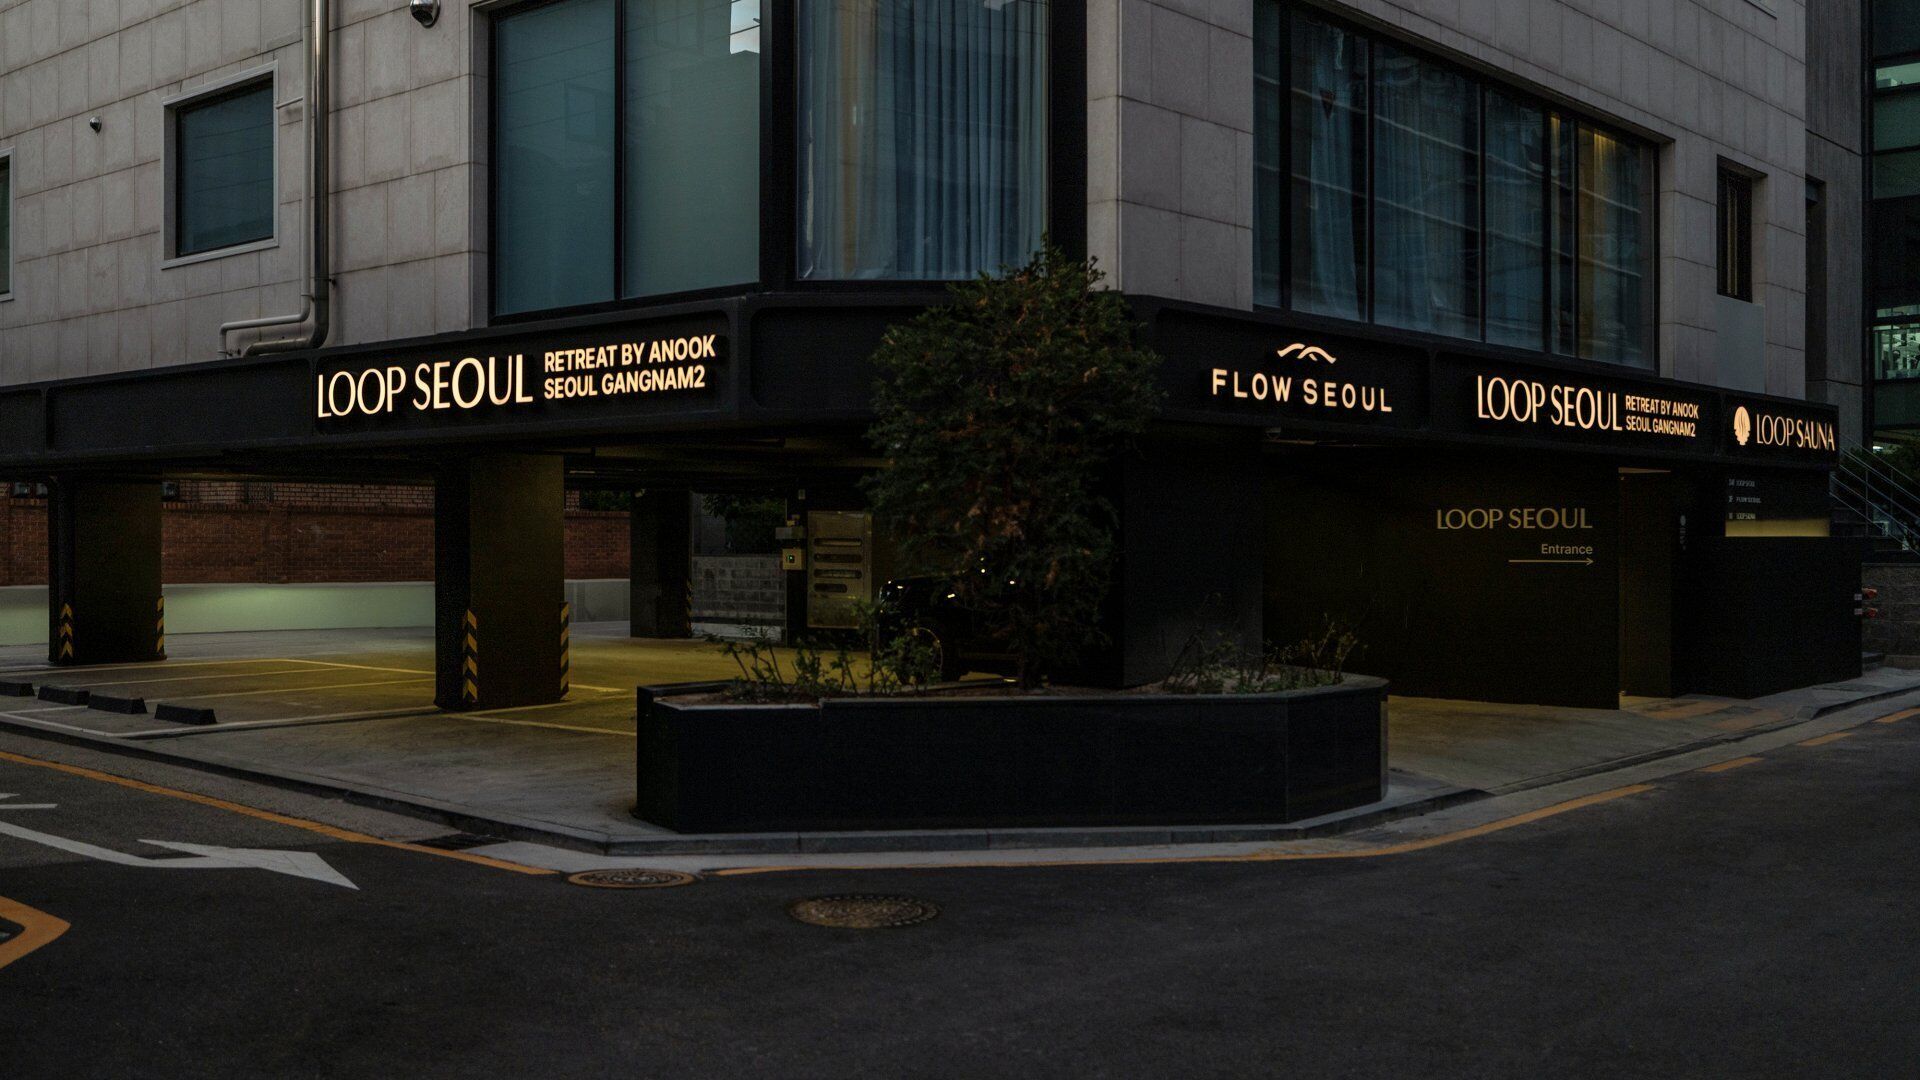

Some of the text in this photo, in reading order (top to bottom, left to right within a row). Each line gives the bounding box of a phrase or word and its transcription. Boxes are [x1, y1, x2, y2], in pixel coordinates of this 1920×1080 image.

[544, 334, 717, 373] RETREAT BY ANOOK
[317, 353, 534, 418] LOOP SEOUL
[543, 365, 706, 400] SEOUL GANGNAM2
[1211, 368, 1393, 413] FLOW SEOUL
[1477, 375, 1624, 431] LOOP SEOUL
[1625, 394, 1699, 419] RETREAT BY ANOOK
[1625, 415, 1697, 437] SEOUL GANGNAM2
[1756, 413, 1836, 452] LOOP SAUNA
[1436, 507, 1594, 530] LOOP SEOUL
[1541, 543, 1594, 555] Entrance
